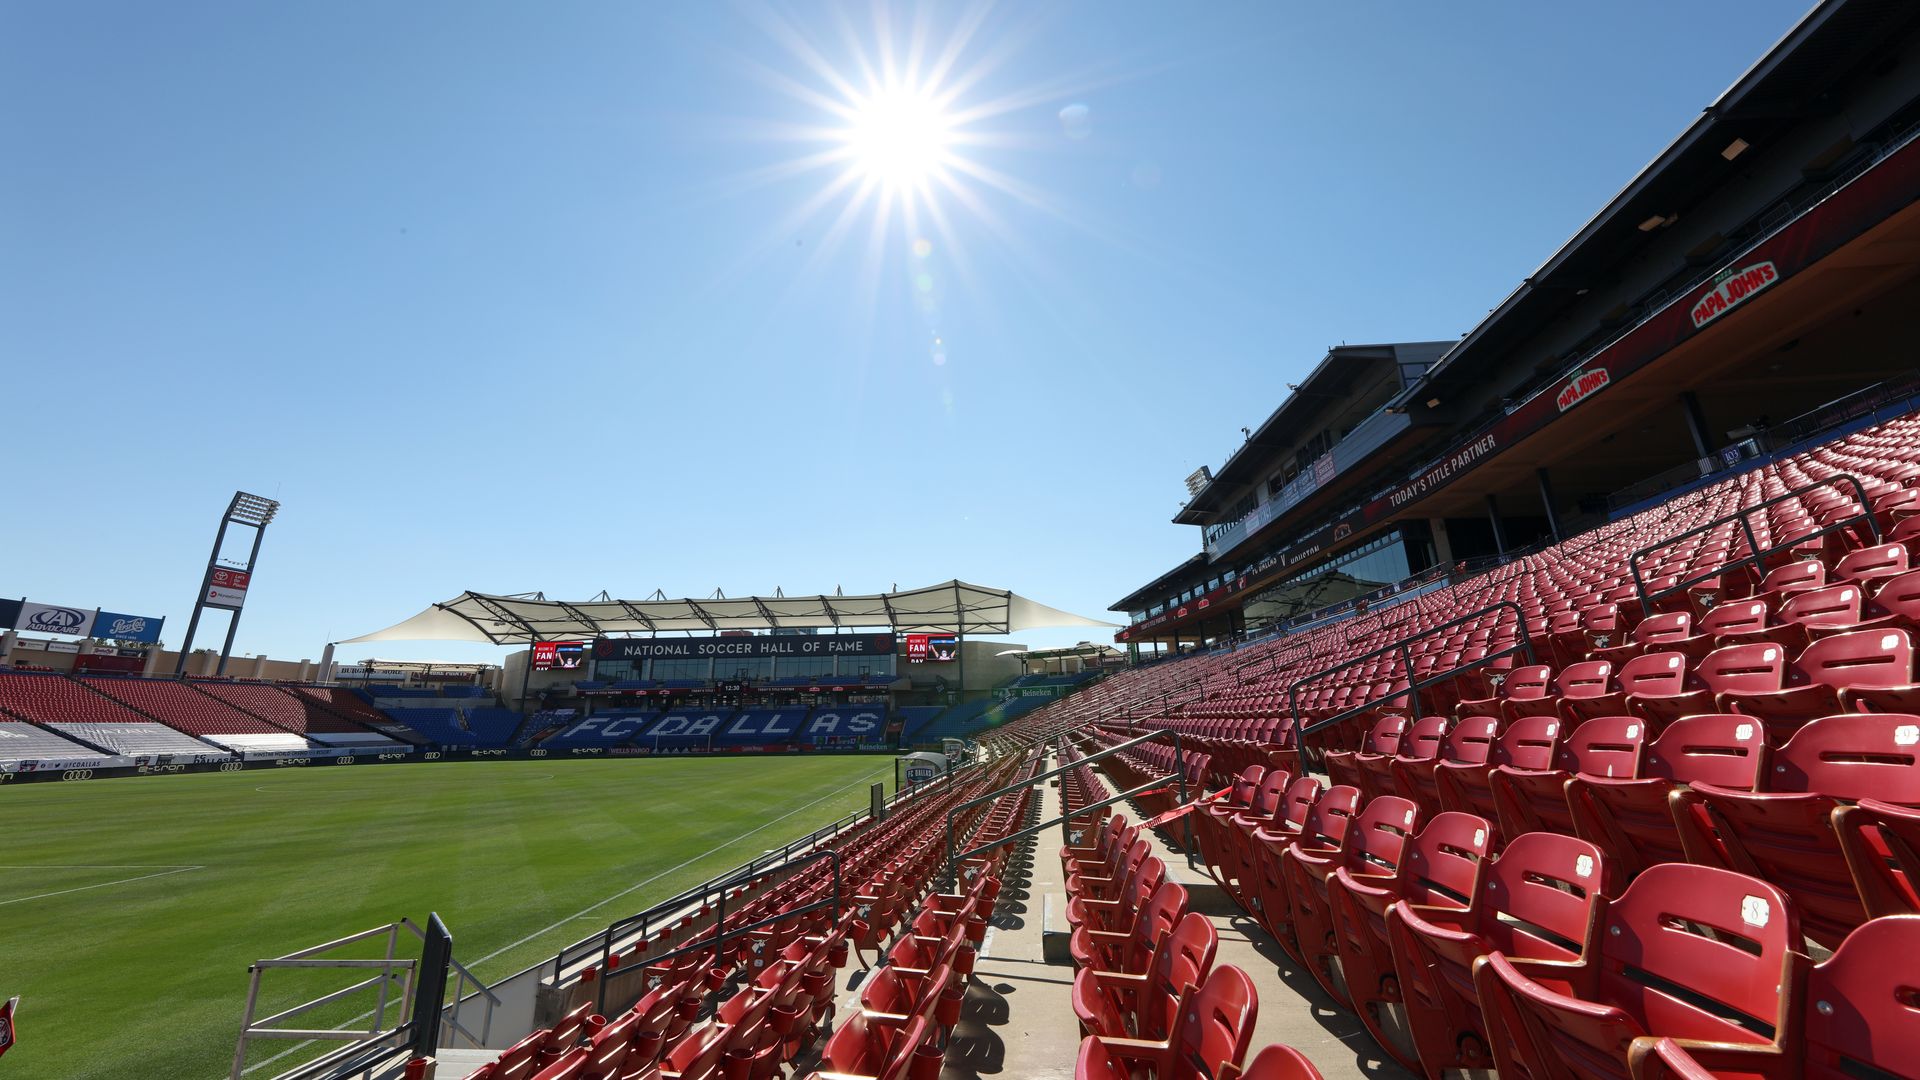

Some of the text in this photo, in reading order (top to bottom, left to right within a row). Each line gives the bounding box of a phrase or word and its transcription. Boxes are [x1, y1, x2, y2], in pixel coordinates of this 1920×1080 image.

[1694, 263, 1775, 324] PAPA JOHN'S
[1558, 370, 1609, 409] PAPA JOHN'S
[1725, 449, 1739, 461] 103
[1390, 434, 1497, 507] TODAY'S TITLE PARTNER
[26, 623, 80, 635] ADVOCARE
[624, 641, 863, 656] NATIONAL SOCCER HALL OF FAME
[910, 644, 926, 652] FAN
[536, 652, 553, 660] FAN
[1022, 689, 1052, 697] Heineken
[563, 712, 880, 737] FC DALLAS
[471, 749, 507, 757] e-tron
[63, 761, 101, 769] @FCDALLAS
[275, 758, 311, 766] e-tron
[138, 764, 185, 775] e-tron
[907, 769, 932, 778] FC DALLAS
[1752, 901, 1759, 920] 8
